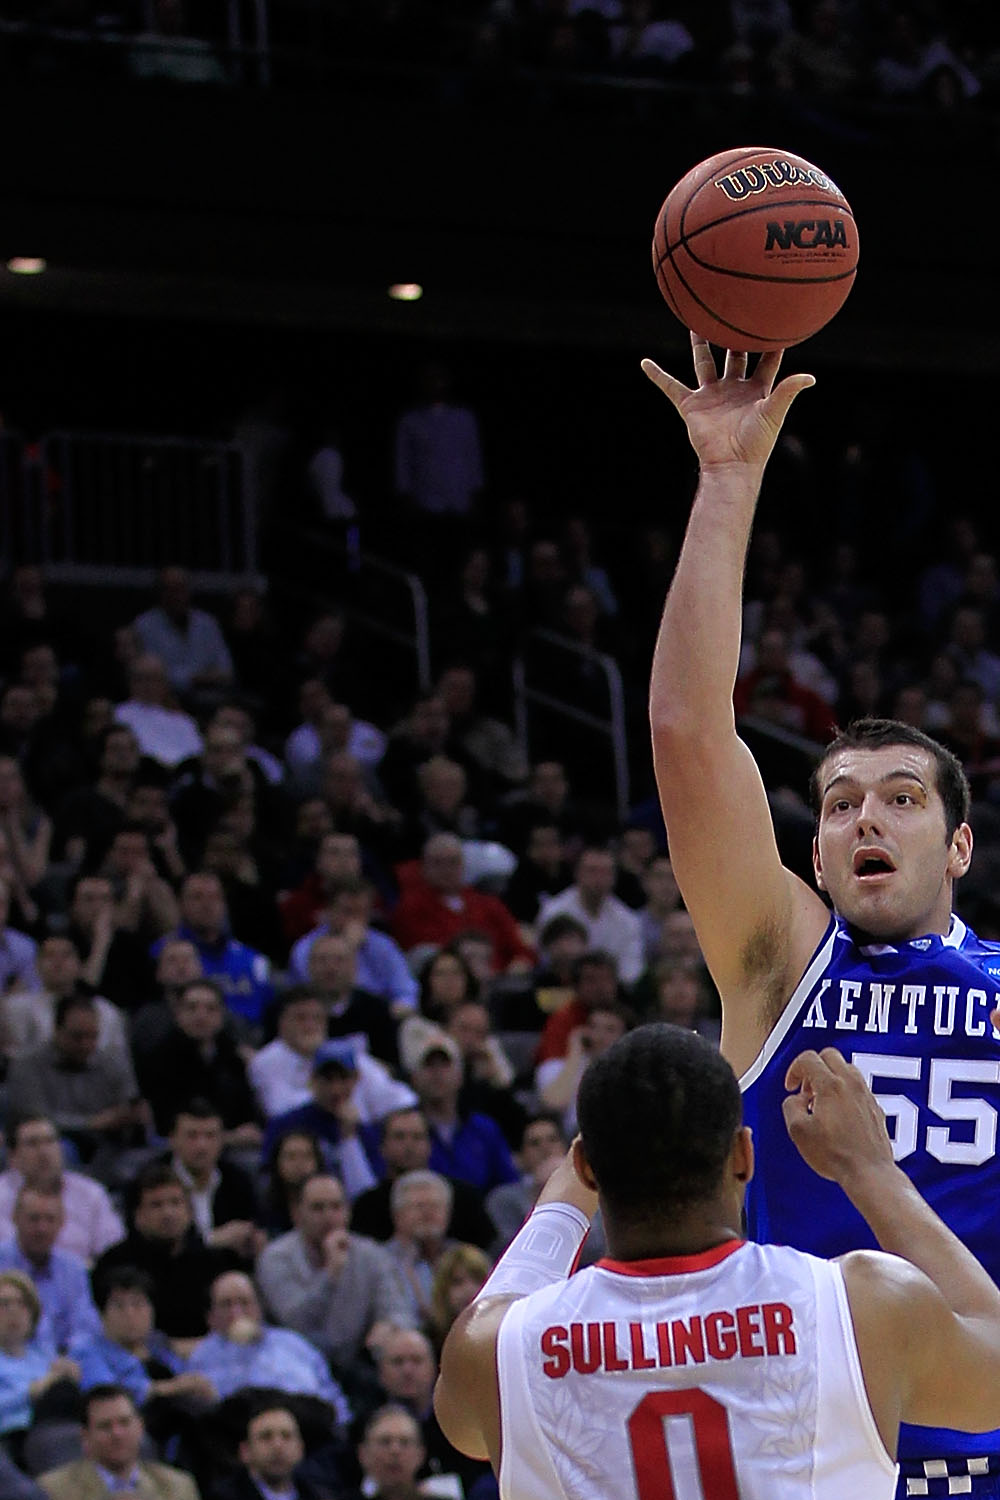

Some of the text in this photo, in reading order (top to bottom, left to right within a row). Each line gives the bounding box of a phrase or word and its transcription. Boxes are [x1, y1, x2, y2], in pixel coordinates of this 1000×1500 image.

[714, 160, 845, 202] Wilso
[764, 219, 848, 251] NCAA
[541, 1302, 797, 1379] SULLINGER
